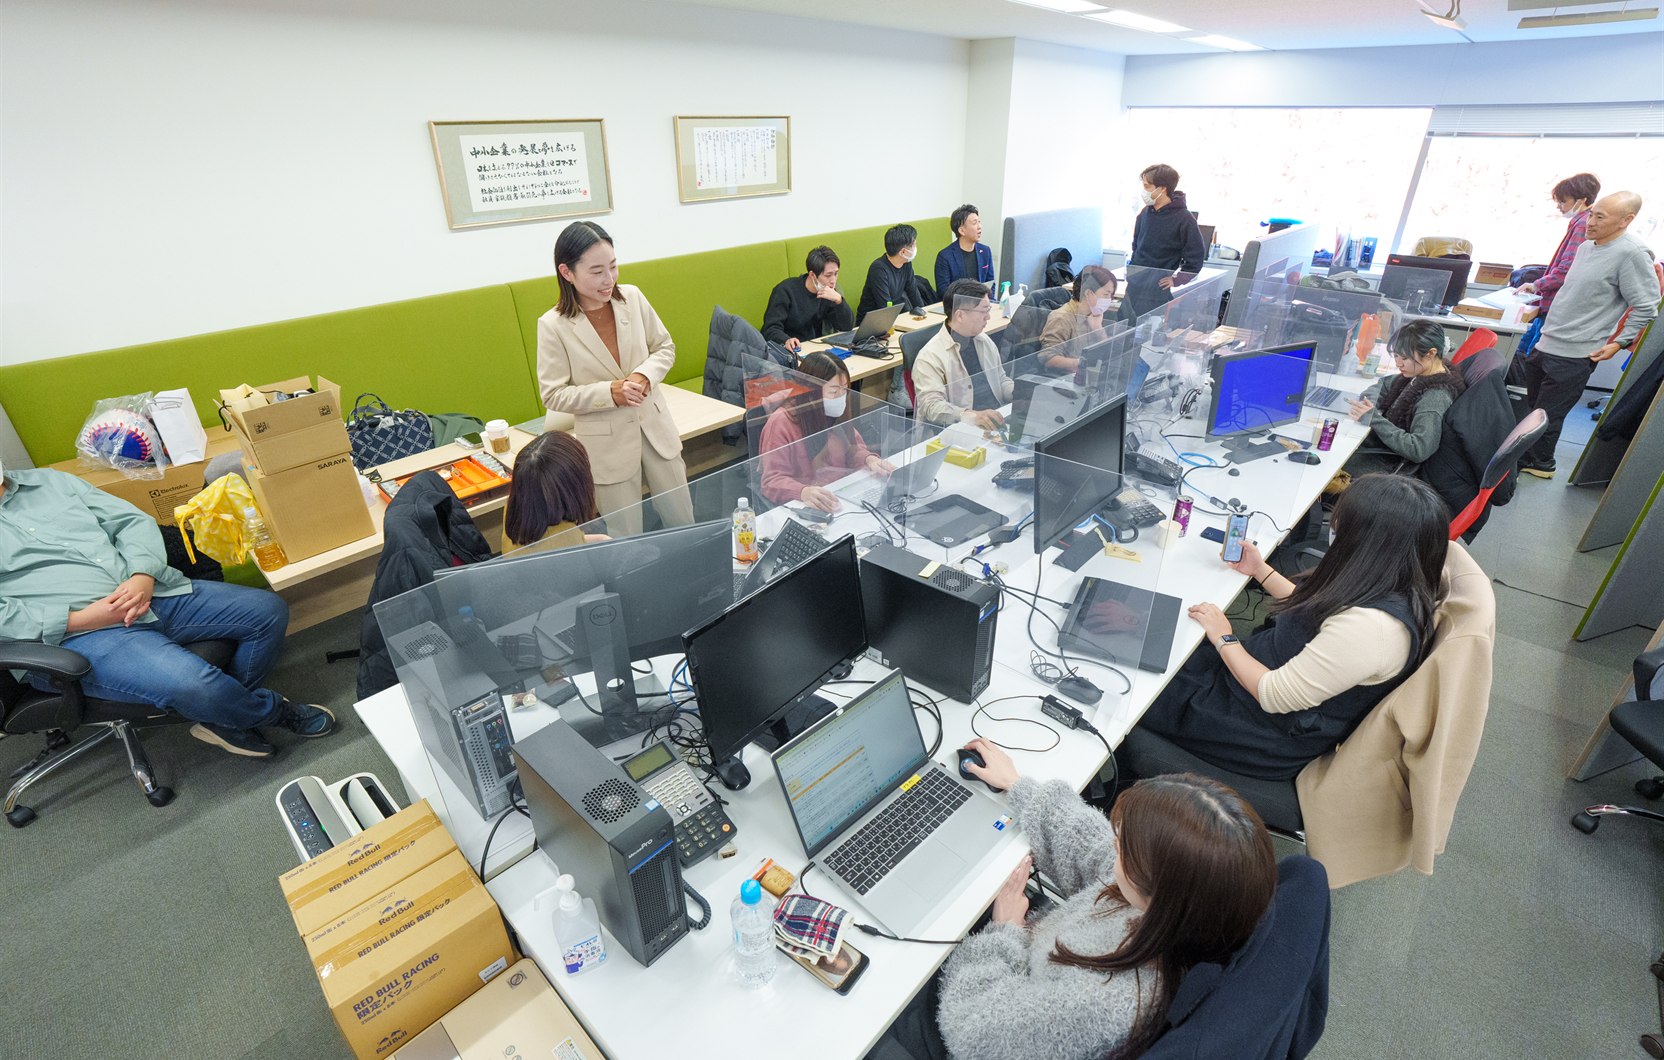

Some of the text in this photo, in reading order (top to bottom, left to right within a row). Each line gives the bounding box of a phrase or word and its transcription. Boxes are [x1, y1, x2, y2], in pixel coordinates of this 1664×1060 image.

[317, 458, 347, 470] SARAYA
[160, 484, 189, 494] Electrolux
[347, 853, 365, 867] Red
[364, 844, 381, 857] Bull
[328, 882, 343, 893] RED
[342, 873, 359, 886] BULL
[358, 858, 383, 876] RACING
[378, 911, 398, 926] Red
[396, 900, 415, 915] Bull
[357, 946, 372, 958] RED
[372, 935, 390, 949] BULL
[389, 919, 416, 939] RACING
[416, 898, 451, 923] 限定パック
[352, 995, 374, 1013] RED
[375, 978, 401, 998] BULL
[401, 952, 440, 981] RACING
[356, 980, 413, 1020] 限定パック
[376, 1030, 408, 1054] Red Bull
